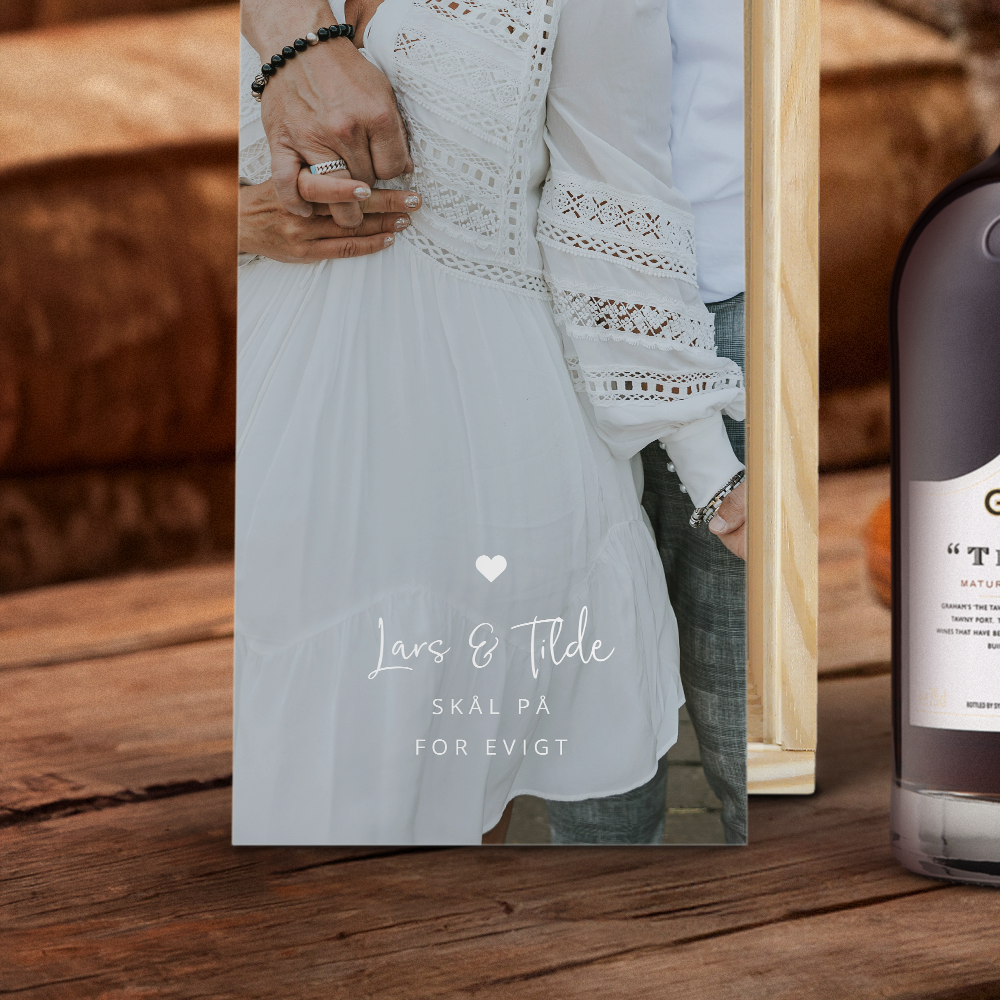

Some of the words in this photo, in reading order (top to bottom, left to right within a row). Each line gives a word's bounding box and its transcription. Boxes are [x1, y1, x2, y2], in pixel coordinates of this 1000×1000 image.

[367, 617, 451, 680] Lars
[468, 622, 499, 669] &
[510, 605, 615, 679] Tilde
[432, 695, 500, 715] SKÅL
[518, 695, 550, 715] PÅ
[415, 739, 468, 756] FOR
[486, 739, 568, 756] EVIGT
